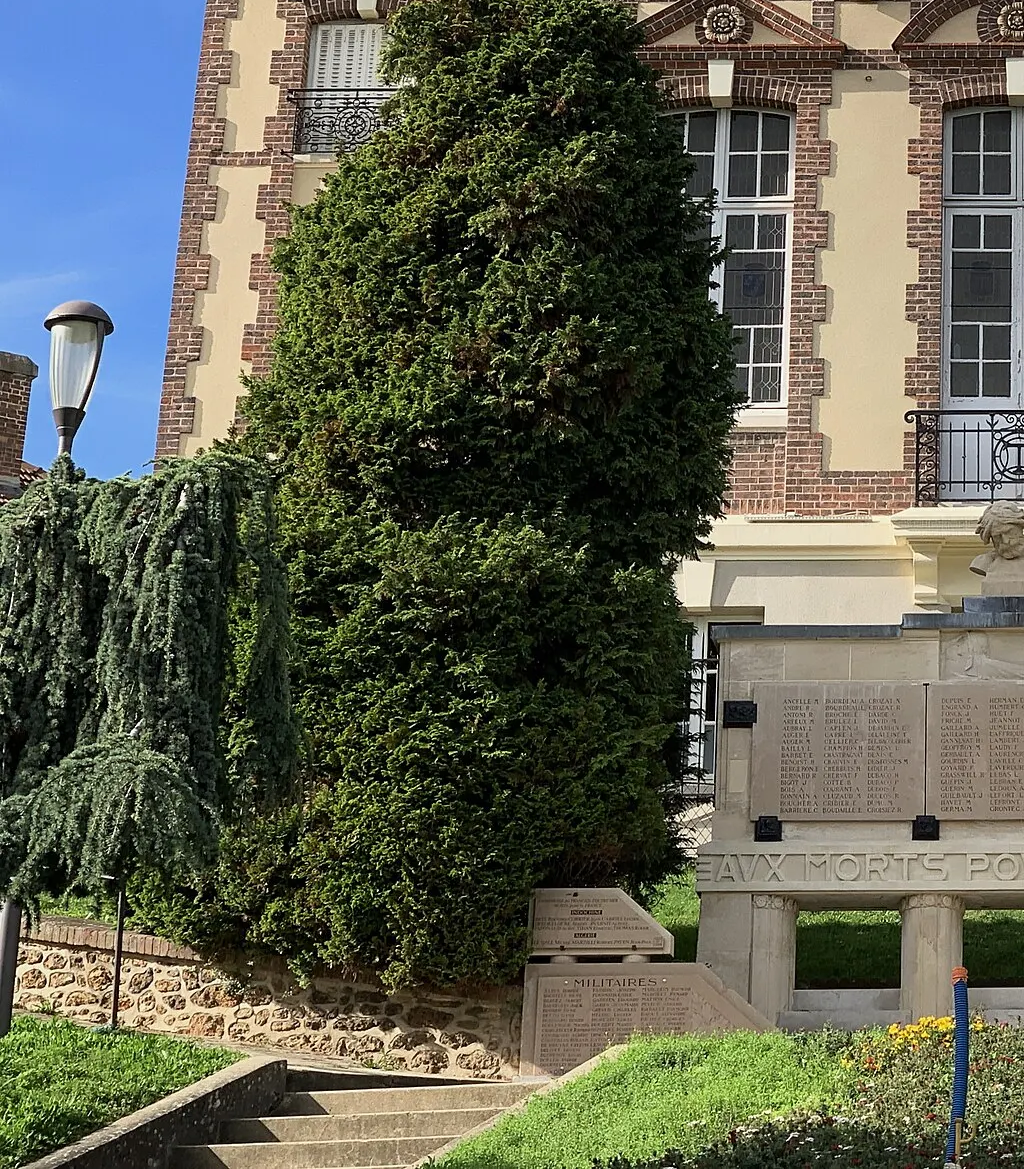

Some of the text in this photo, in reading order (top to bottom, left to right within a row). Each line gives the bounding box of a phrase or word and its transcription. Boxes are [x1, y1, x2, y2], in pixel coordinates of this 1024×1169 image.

[716, 853, 784, 882] AVX
[805, 853, 949, 882] MORTS
[574, 978, 657, 987] MILITAIRES
